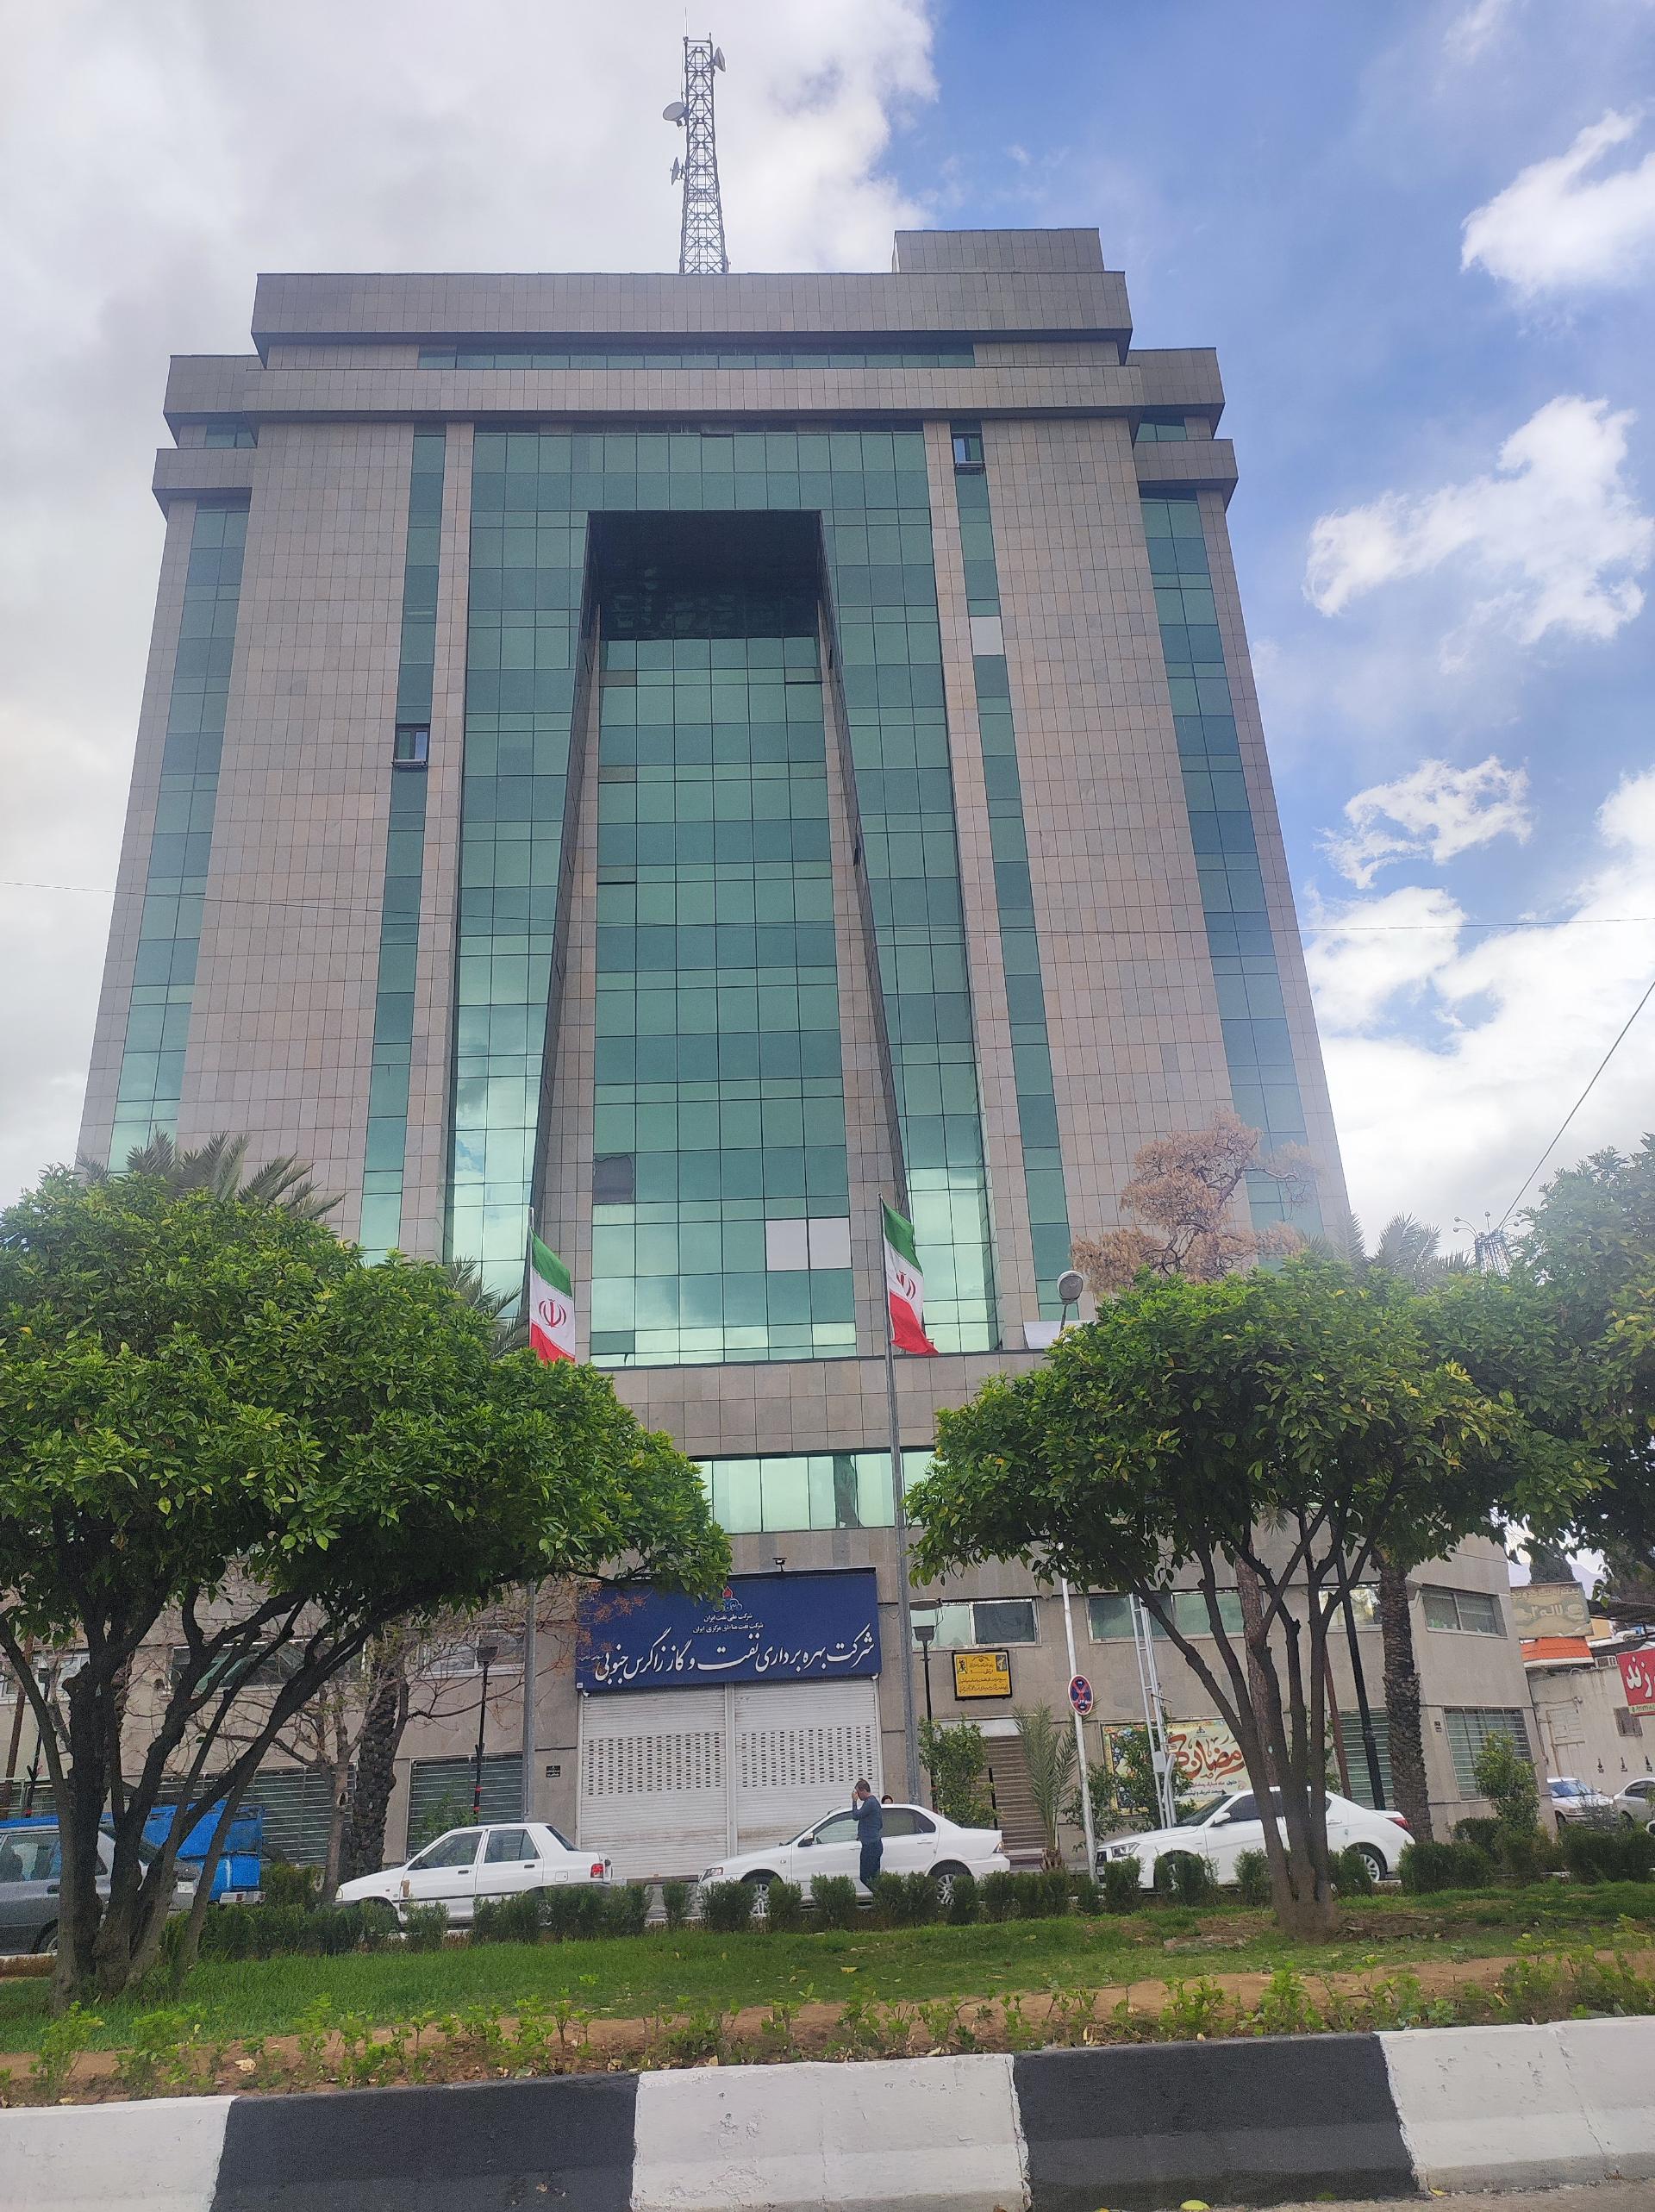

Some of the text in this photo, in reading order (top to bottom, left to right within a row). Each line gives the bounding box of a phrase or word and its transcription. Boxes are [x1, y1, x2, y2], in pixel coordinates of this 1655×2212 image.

[703, 1615, 715, 1623] ایران
[706, 1624, 721, 1633] مرکزی
[623, 1627, 671, 1679] زاگرس
[665, 1639, 692, 1671] گاز
[697, 1632, 760, 1670] نفت
[826, 1623, 875, 1668] شرکت
[595, 1643, 629, 1684] جنوبی
[687, 1657, 696, 1671] و
